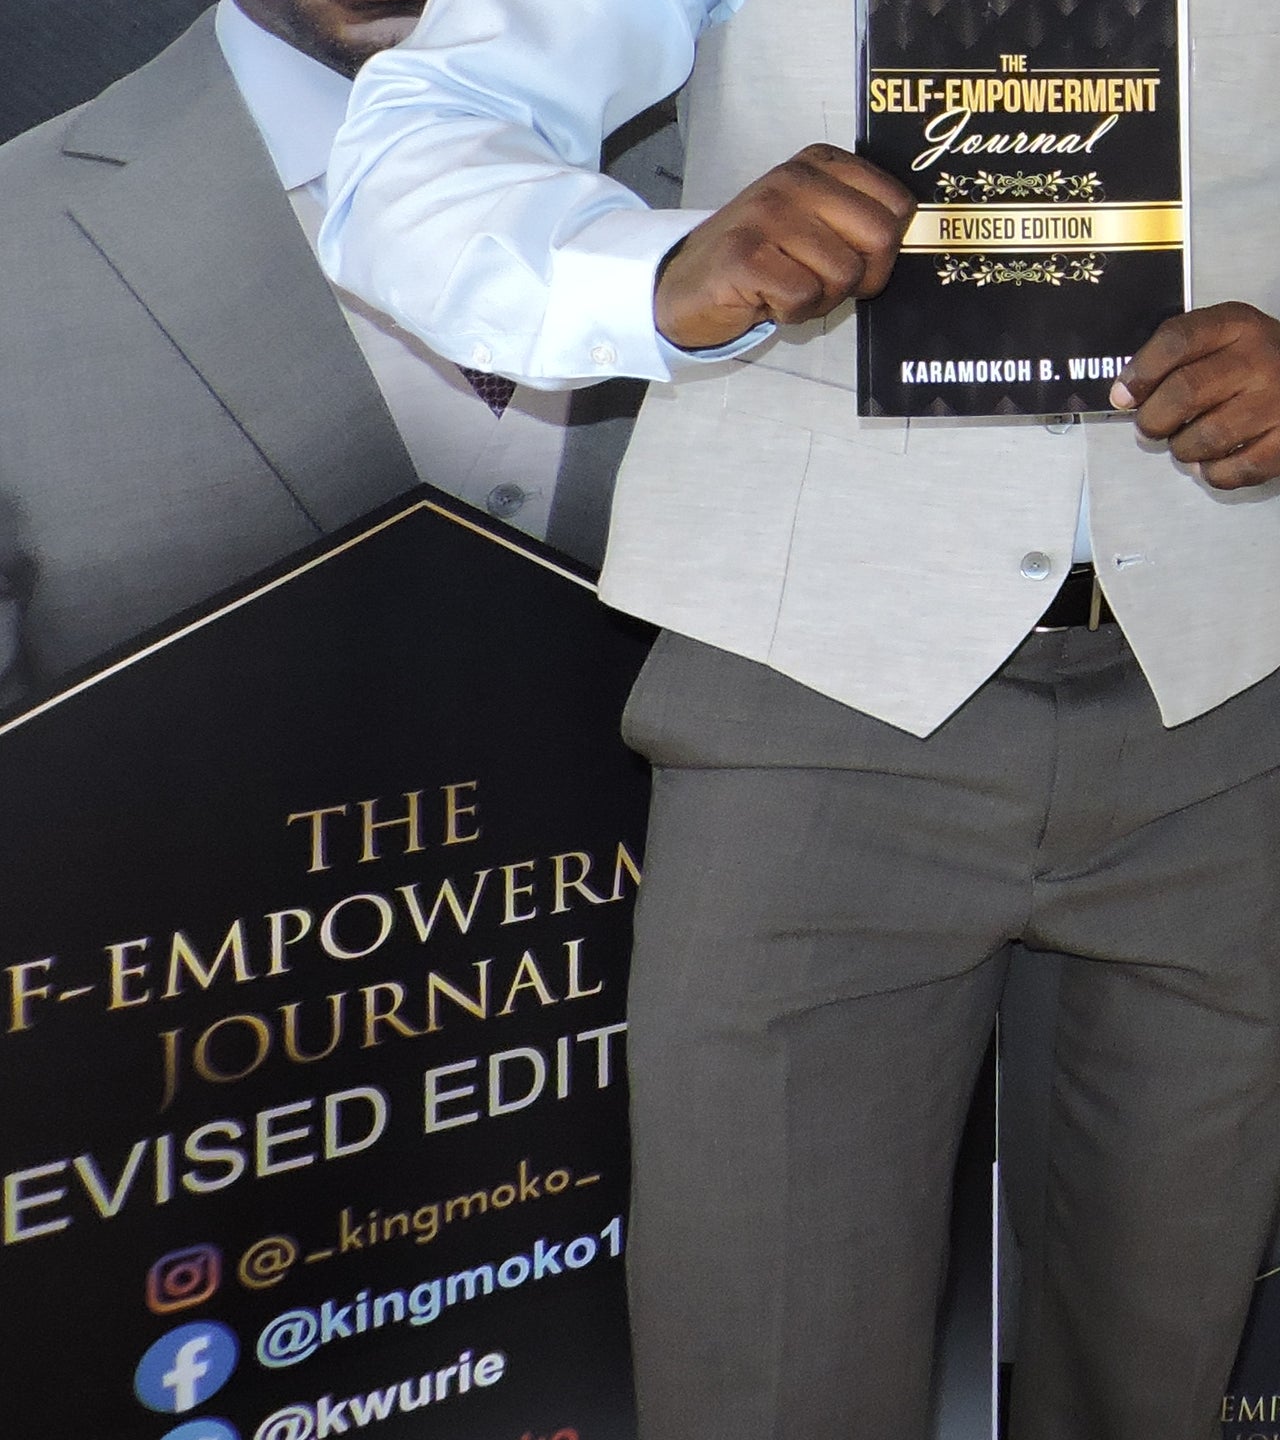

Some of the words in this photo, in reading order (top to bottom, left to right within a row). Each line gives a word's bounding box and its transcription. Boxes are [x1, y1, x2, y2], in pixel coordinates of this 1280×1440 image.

[1000, 54, 1027, 73] THE
[870, 77, 1160, 114] SELF-EMPOWERMENT
[911, 107, 1120, 172] Journal
[939, 217, 1016, 241] REVISED
[1021, 215, 1093, 240] EDITION
[902, 359, 1031, 384] KARAMOKOH
[1039, 358, 1060, 381] B.
[286, 780, 481, 874] THE
[157, 938, 603, 1113] JOURNAL
[2, 1086, 388, 1245] EVISED
[423, 1022, 628, 1134] EDIT
